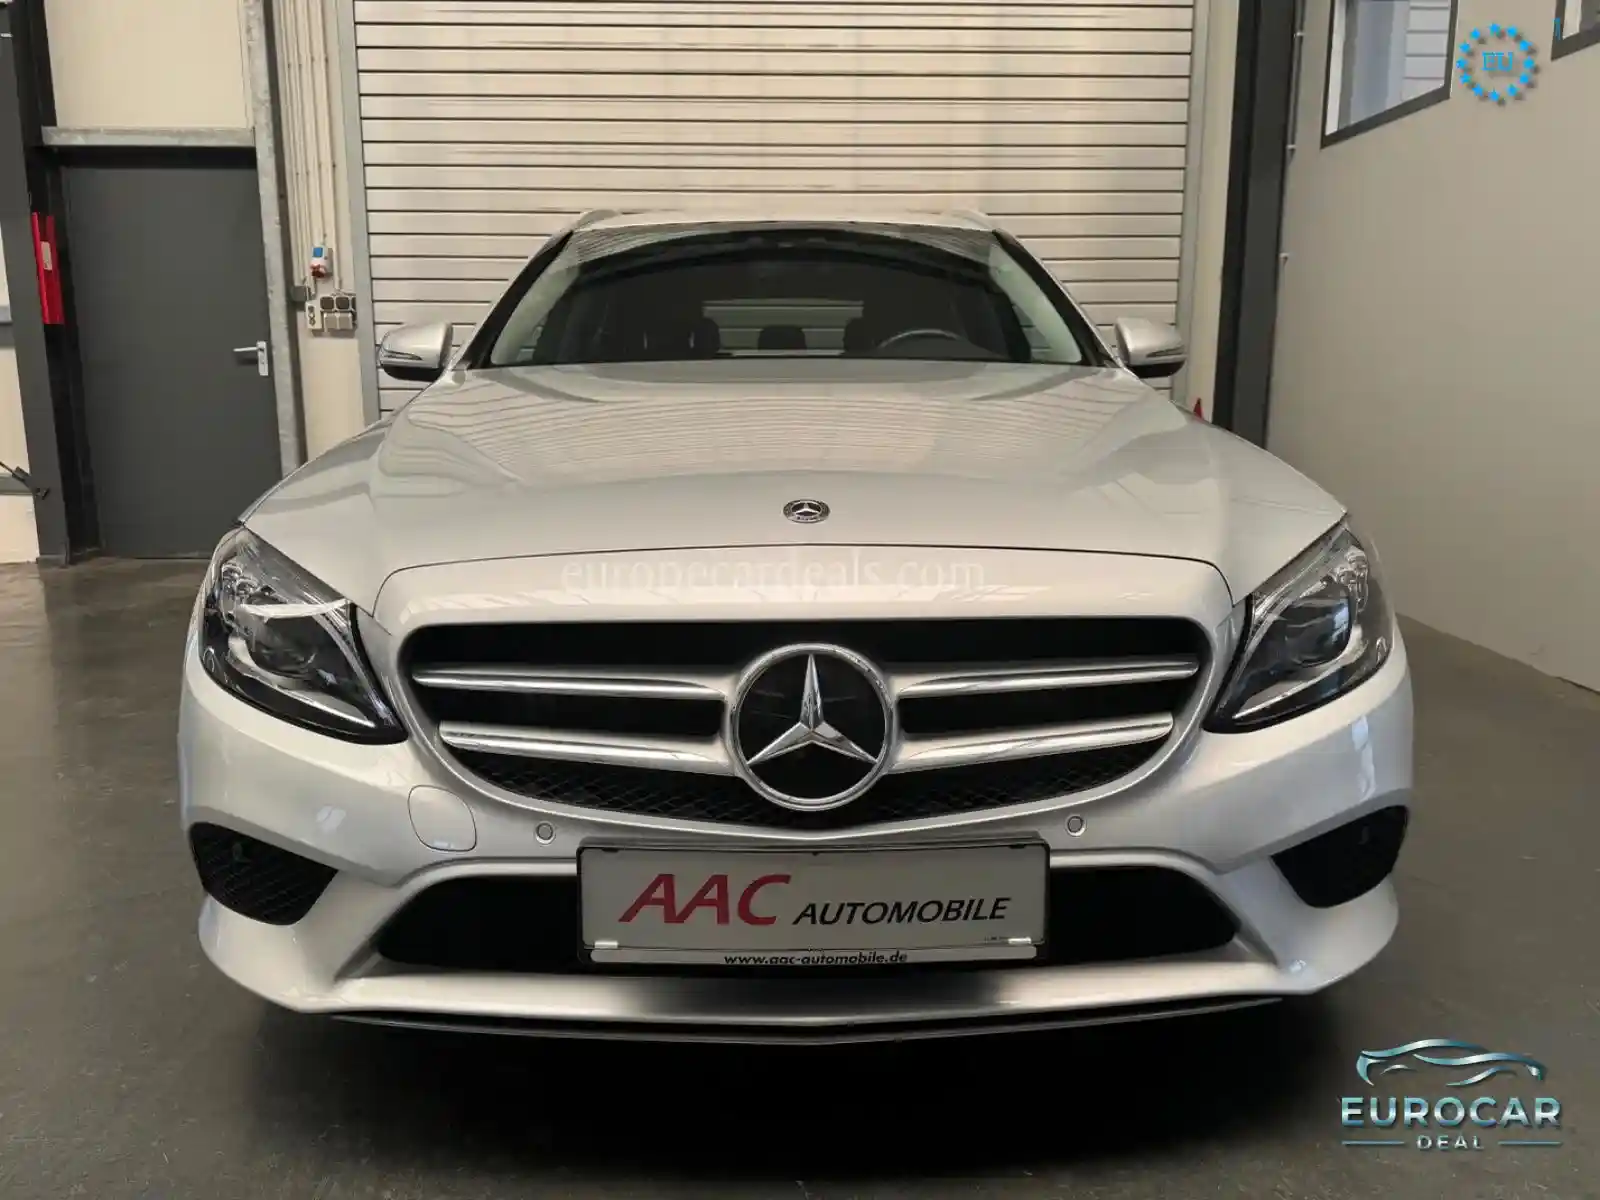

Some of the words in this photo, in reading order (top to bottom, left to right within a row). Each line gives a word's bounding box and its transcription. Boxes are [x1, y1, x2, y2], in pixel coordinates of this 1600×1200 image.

[618, 873, 792, 926] AAC
[793, 897, 1012, 926] AUTOMOBILE
[723, 951, 908, 966] www.aac-automobile.de
